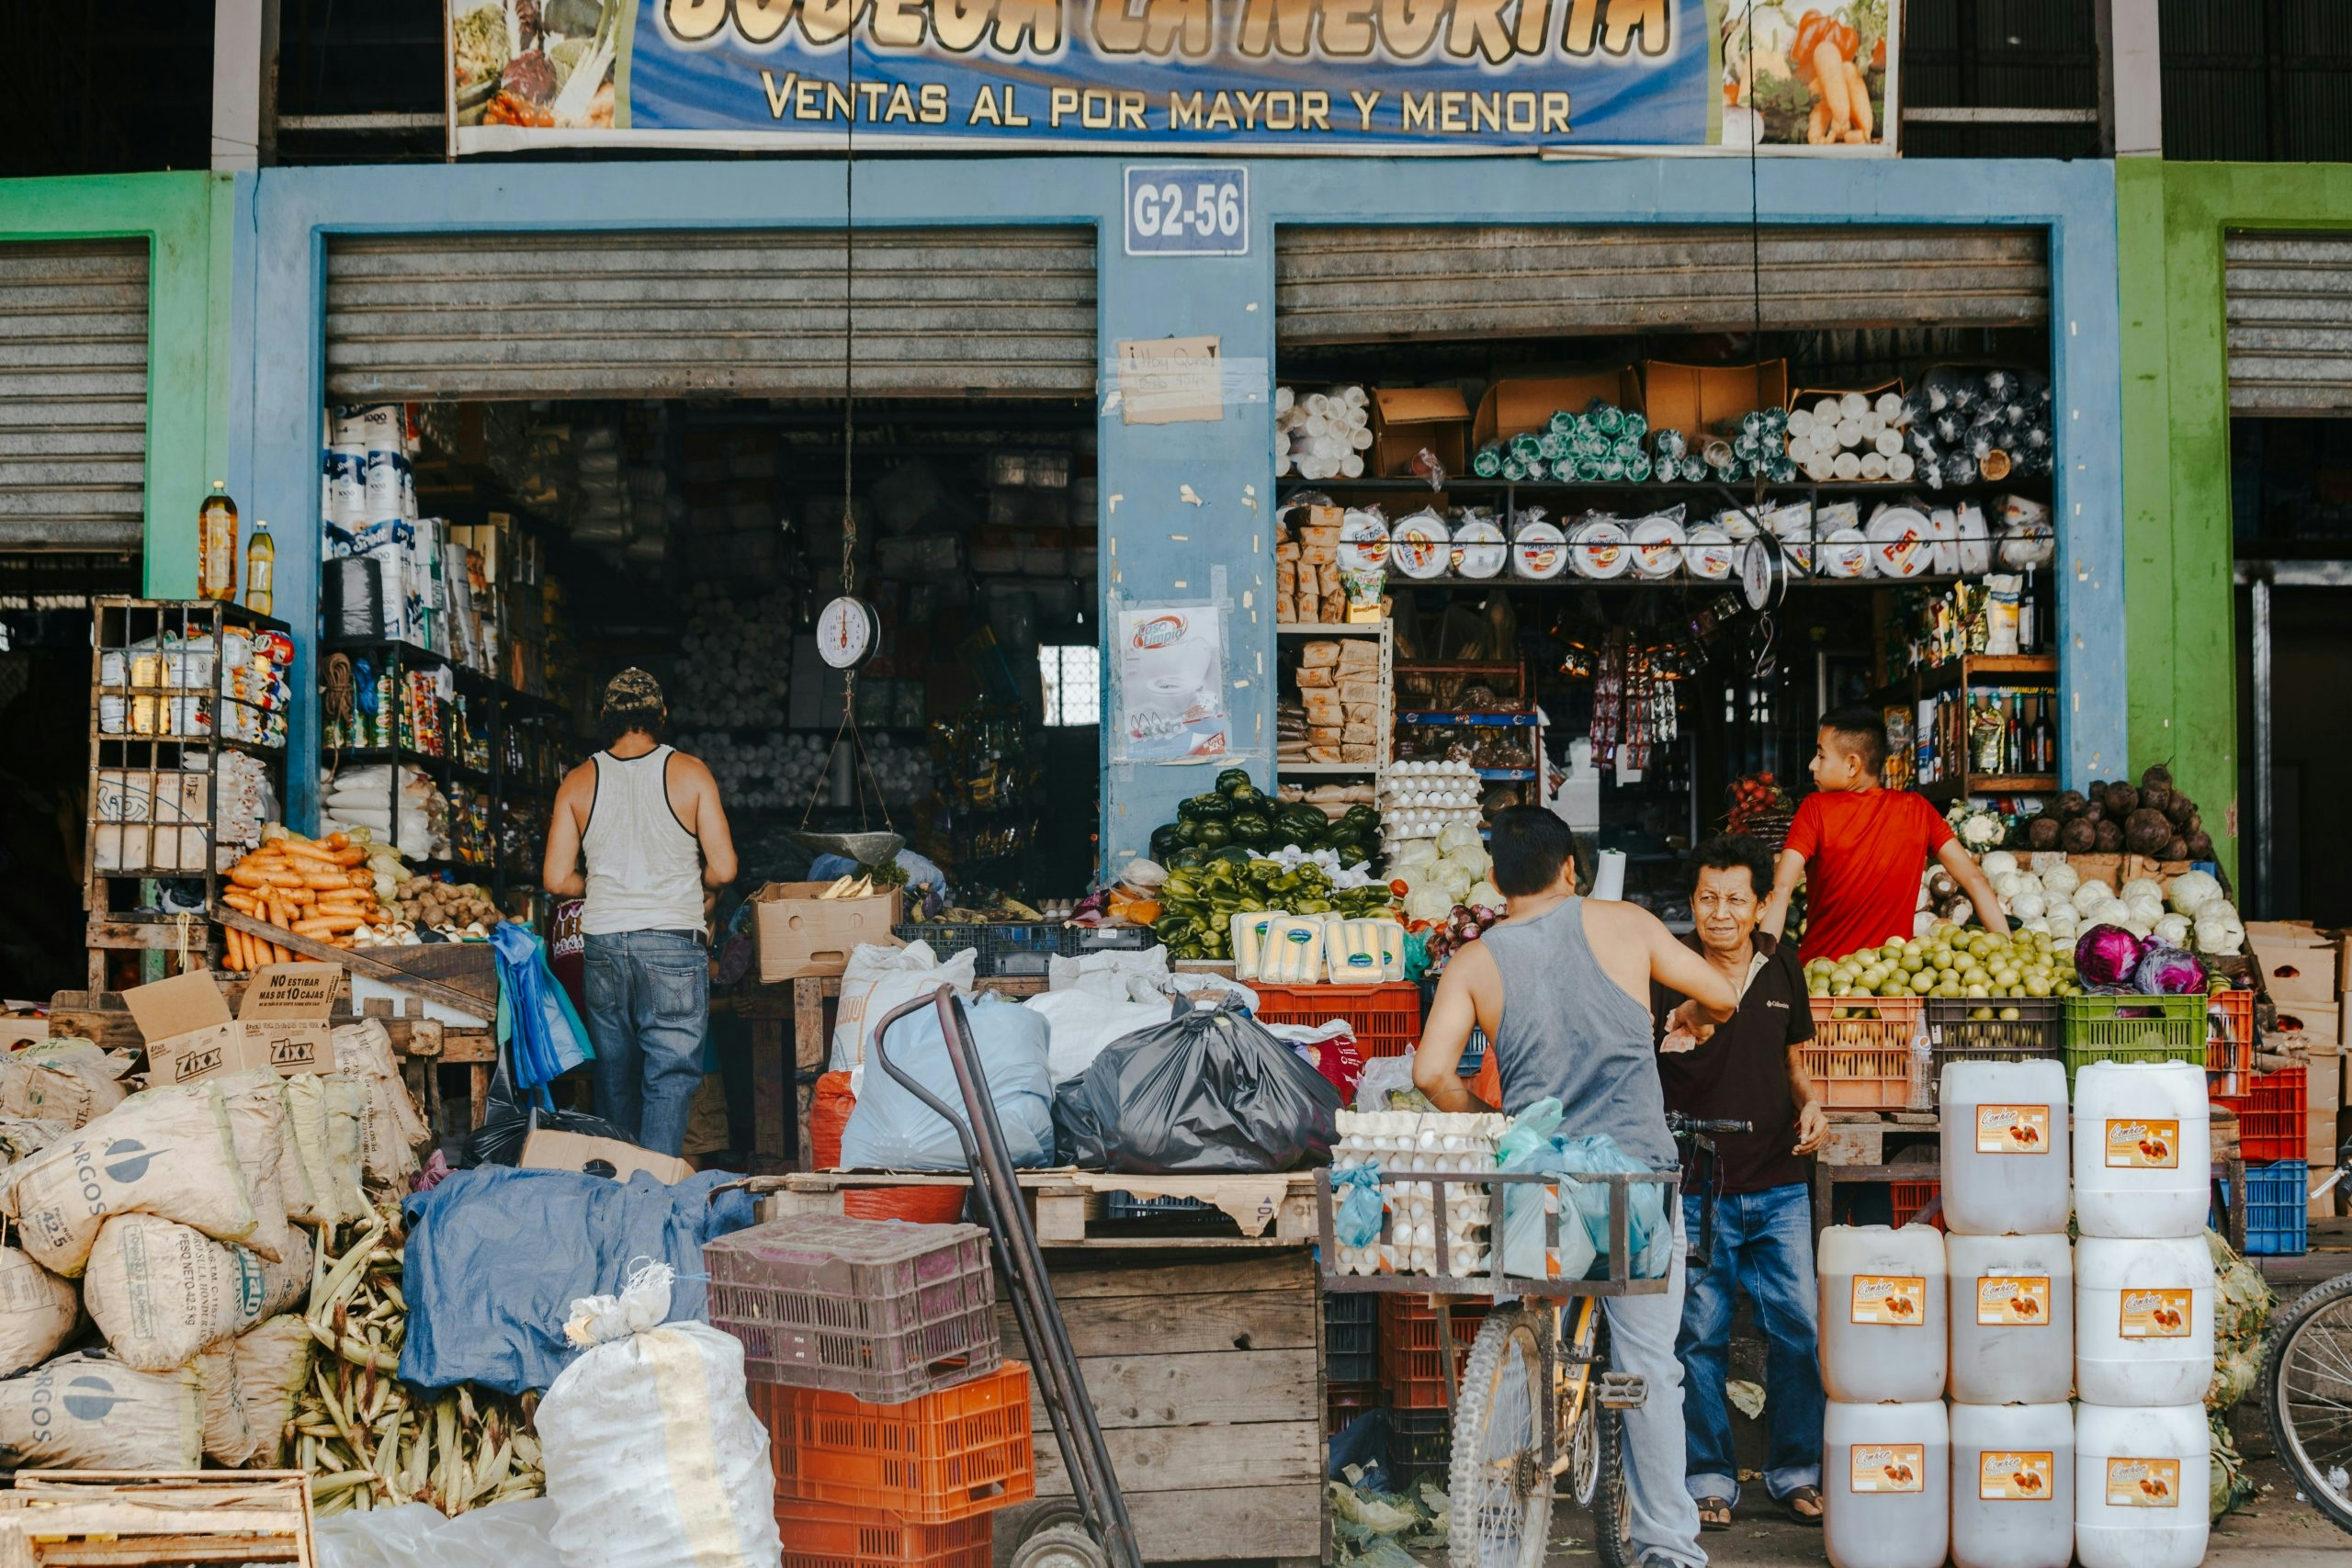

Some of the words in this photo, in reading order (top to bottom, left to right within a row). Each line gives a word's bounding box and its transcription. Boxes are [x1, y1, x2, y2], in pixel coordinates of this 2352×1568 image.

[760, 71, 947, 123] VENTAS
[968, 85, 1029, 127] AL
[1050, 86, 1148, 130] POR
[1170, 90, 1330, 130] MAYOR
[1351, 90, 1381, 130] Y
[1402, 91, 1572, 133] MENOR
[1134, 183, 1239, 237] G2-56
[1143, 627, 1183, 647] Limpia
[259, 991, 275, 999] MAS
[277, 991, 285, 999] DE
[287, 987, 300, 999] 10
[300, 990, 324, 999] CAJAS
[271, 975, 286, 987] NO
[288, 978, 320, 987] ESTIBAR
[73, 1141, 107, 1216] ARGOS
[43, 1212, 67, 1247] 42.5
[179, 1233, 192, 1259] PESO
[184, 1262, 196, 1289] NETO
[186, 1291, 197, 1312] 42.5
[186, 1314, 197, 1326] kg
